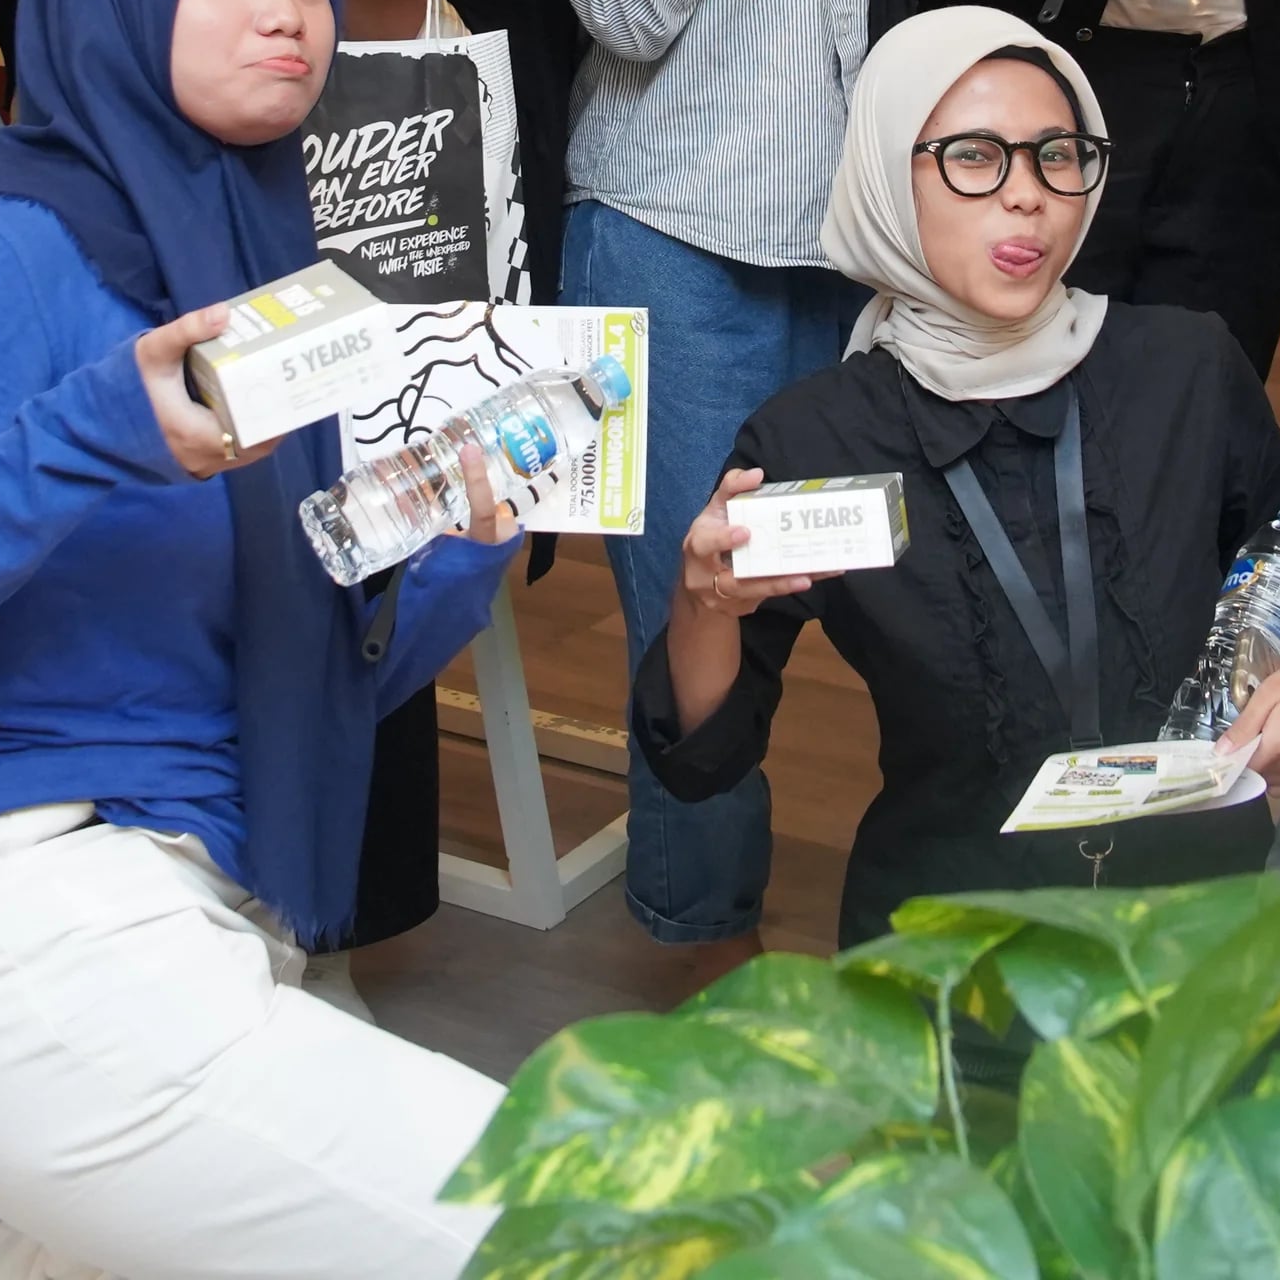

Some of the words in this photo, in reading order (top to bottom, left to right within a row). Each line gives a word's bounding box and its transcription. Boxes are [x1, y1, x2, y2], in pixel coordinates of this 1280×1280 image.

[302, 109, 454, 175] OUDER
[307, 172, 352, 205] AN
[358, 151, 436, 191] EVER
[313, 185, 425, 230] BEFORE
[361, 237, 397, 260] NEW
[399, 226, 469, 251] EXPERIENCE
[378, 255, 408, 275] WITH
[409, 248, 424, 262] THE
[426, 241, 470, 258] UNEXPECTED
[281, 359, 298, 383] 5
[302, 327, 374, 376] YEARS
[608, 324, 626, 367] OL.4
[605, 415, 625, 488] BANGOR
[570, 457, 579, 492] DOORPR
[570, 494, 578, 518] TOTAL
[780, 512, 792, 531] 5
[798, 505, 864, 529] YEARS
